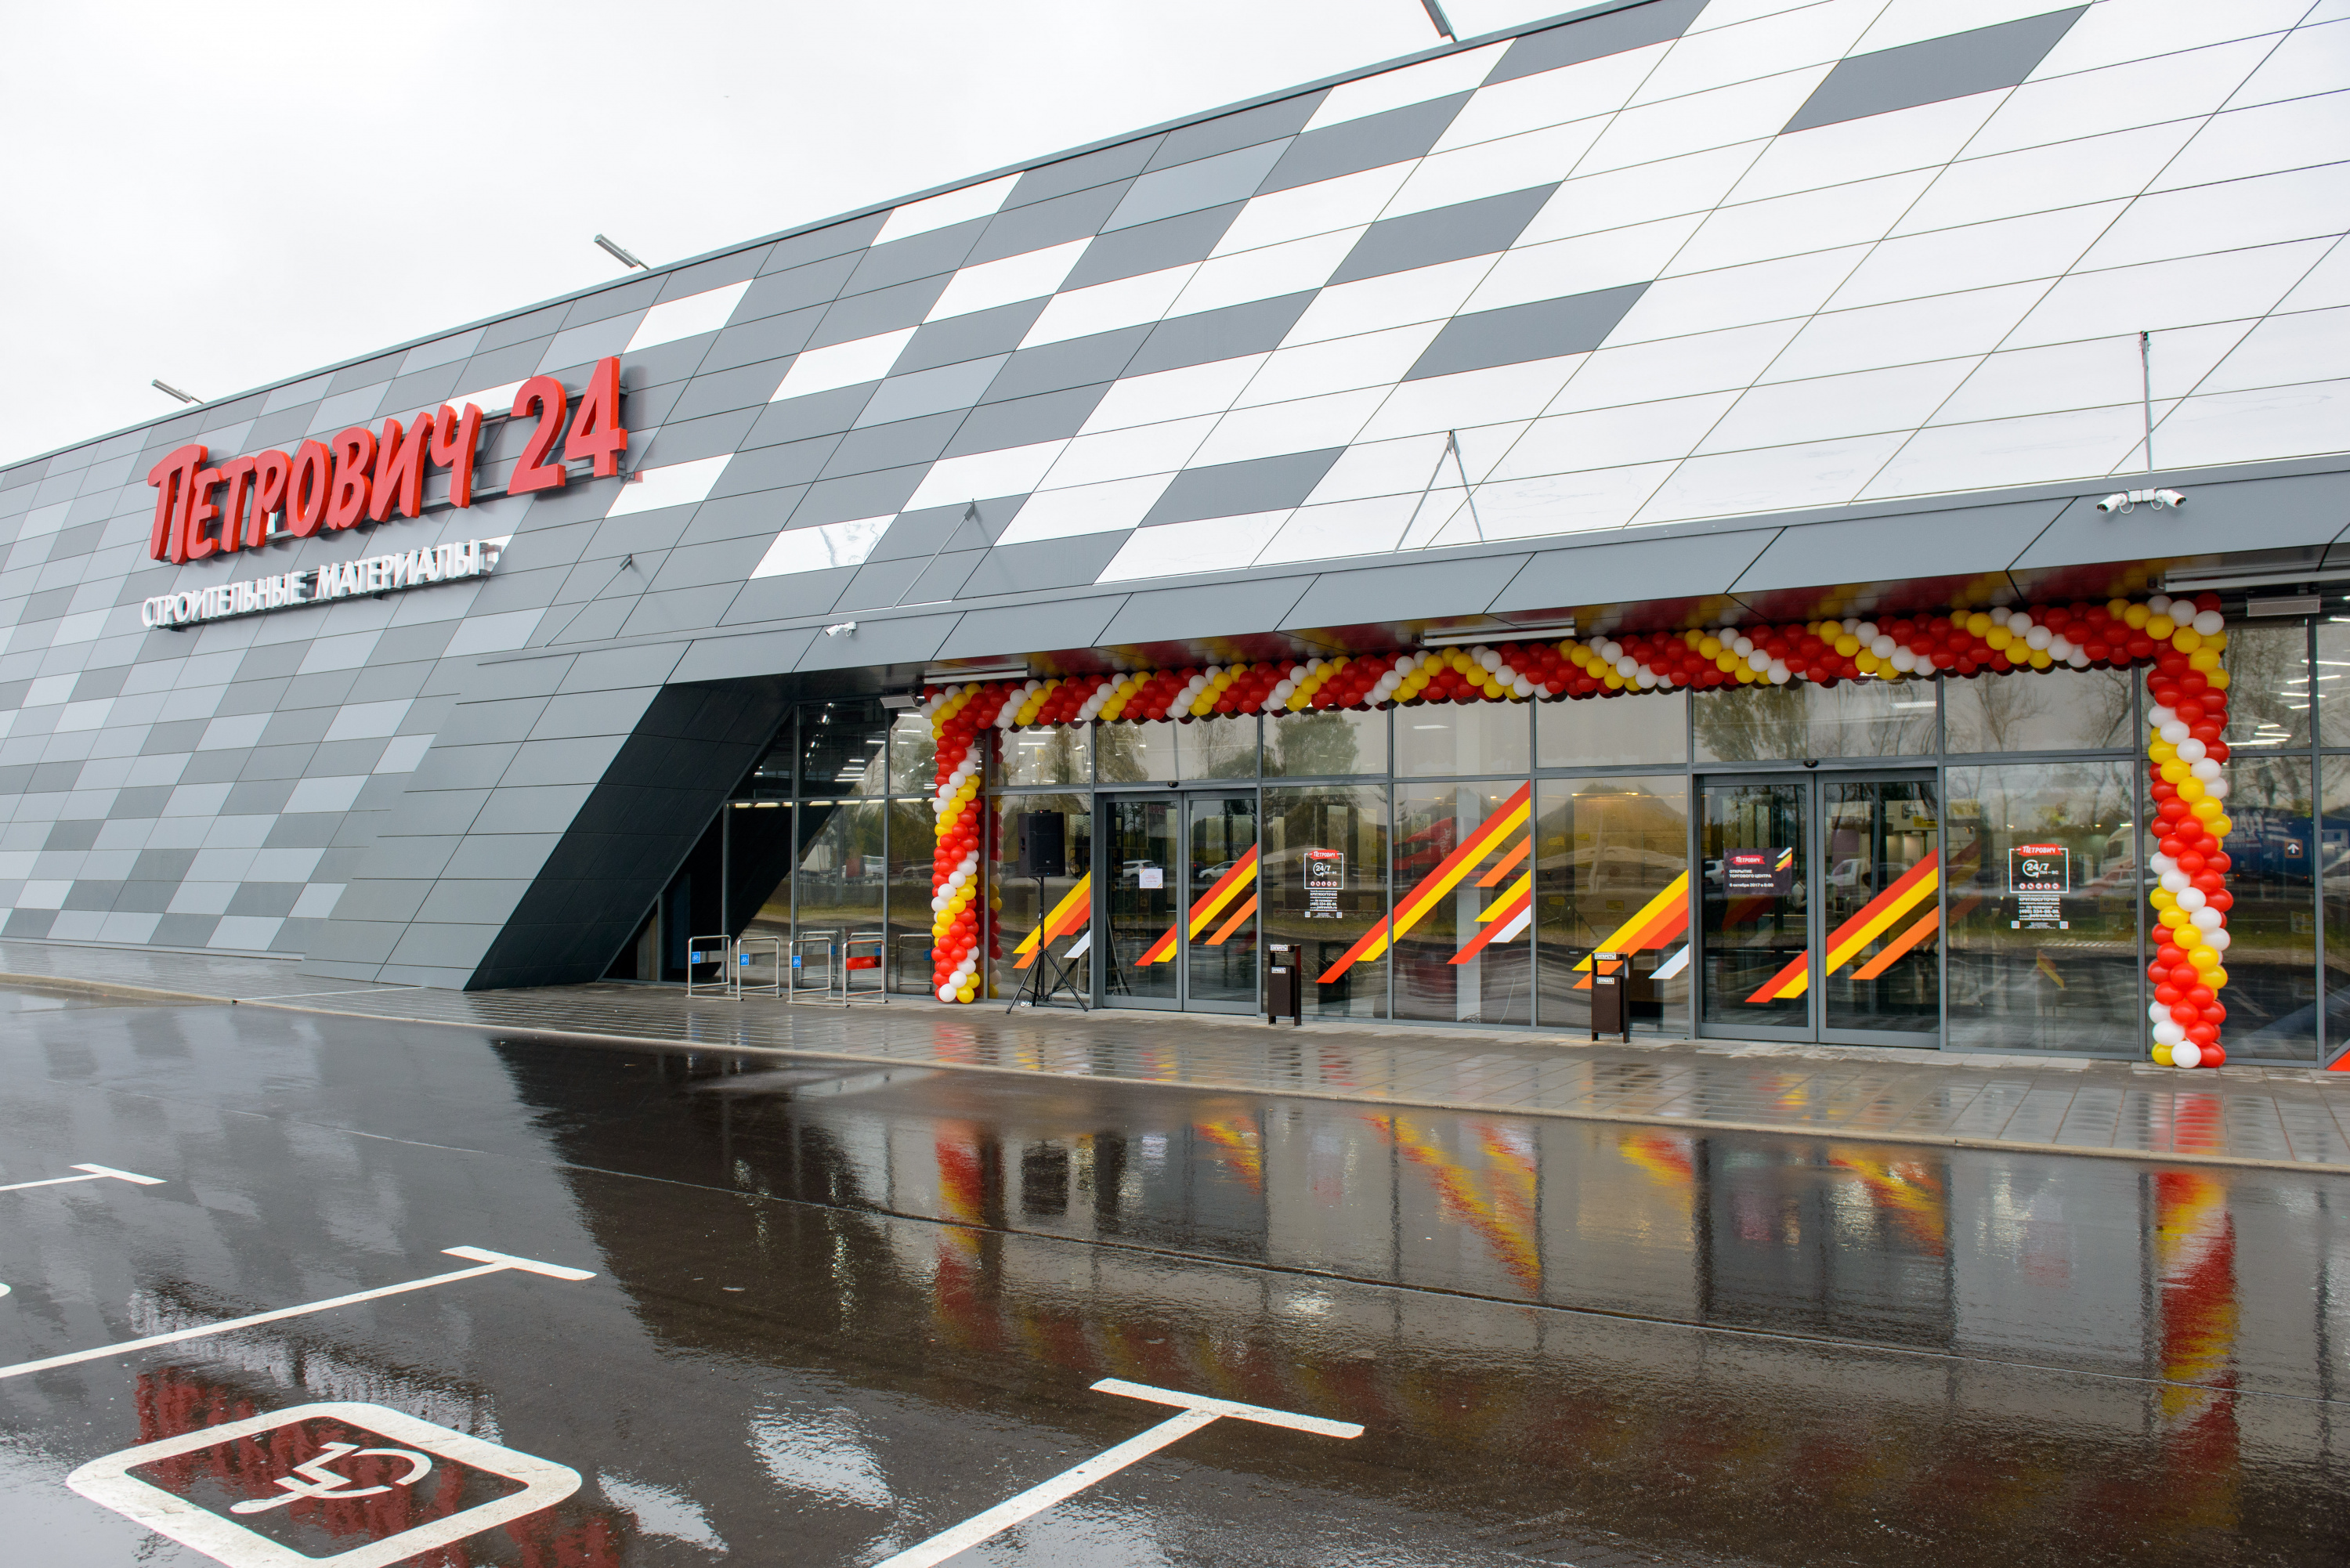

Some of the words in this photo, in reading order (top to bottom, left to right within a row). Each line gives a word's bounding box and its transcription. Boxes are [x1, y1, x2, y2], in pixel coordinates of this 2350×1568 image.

[508, 356, 627, 495] 24
[142, 571, 307, 627] СТРОИТЕЛЬНЫЕ
[315, 539, 480, 600] МАТЕРИАЛЫ
